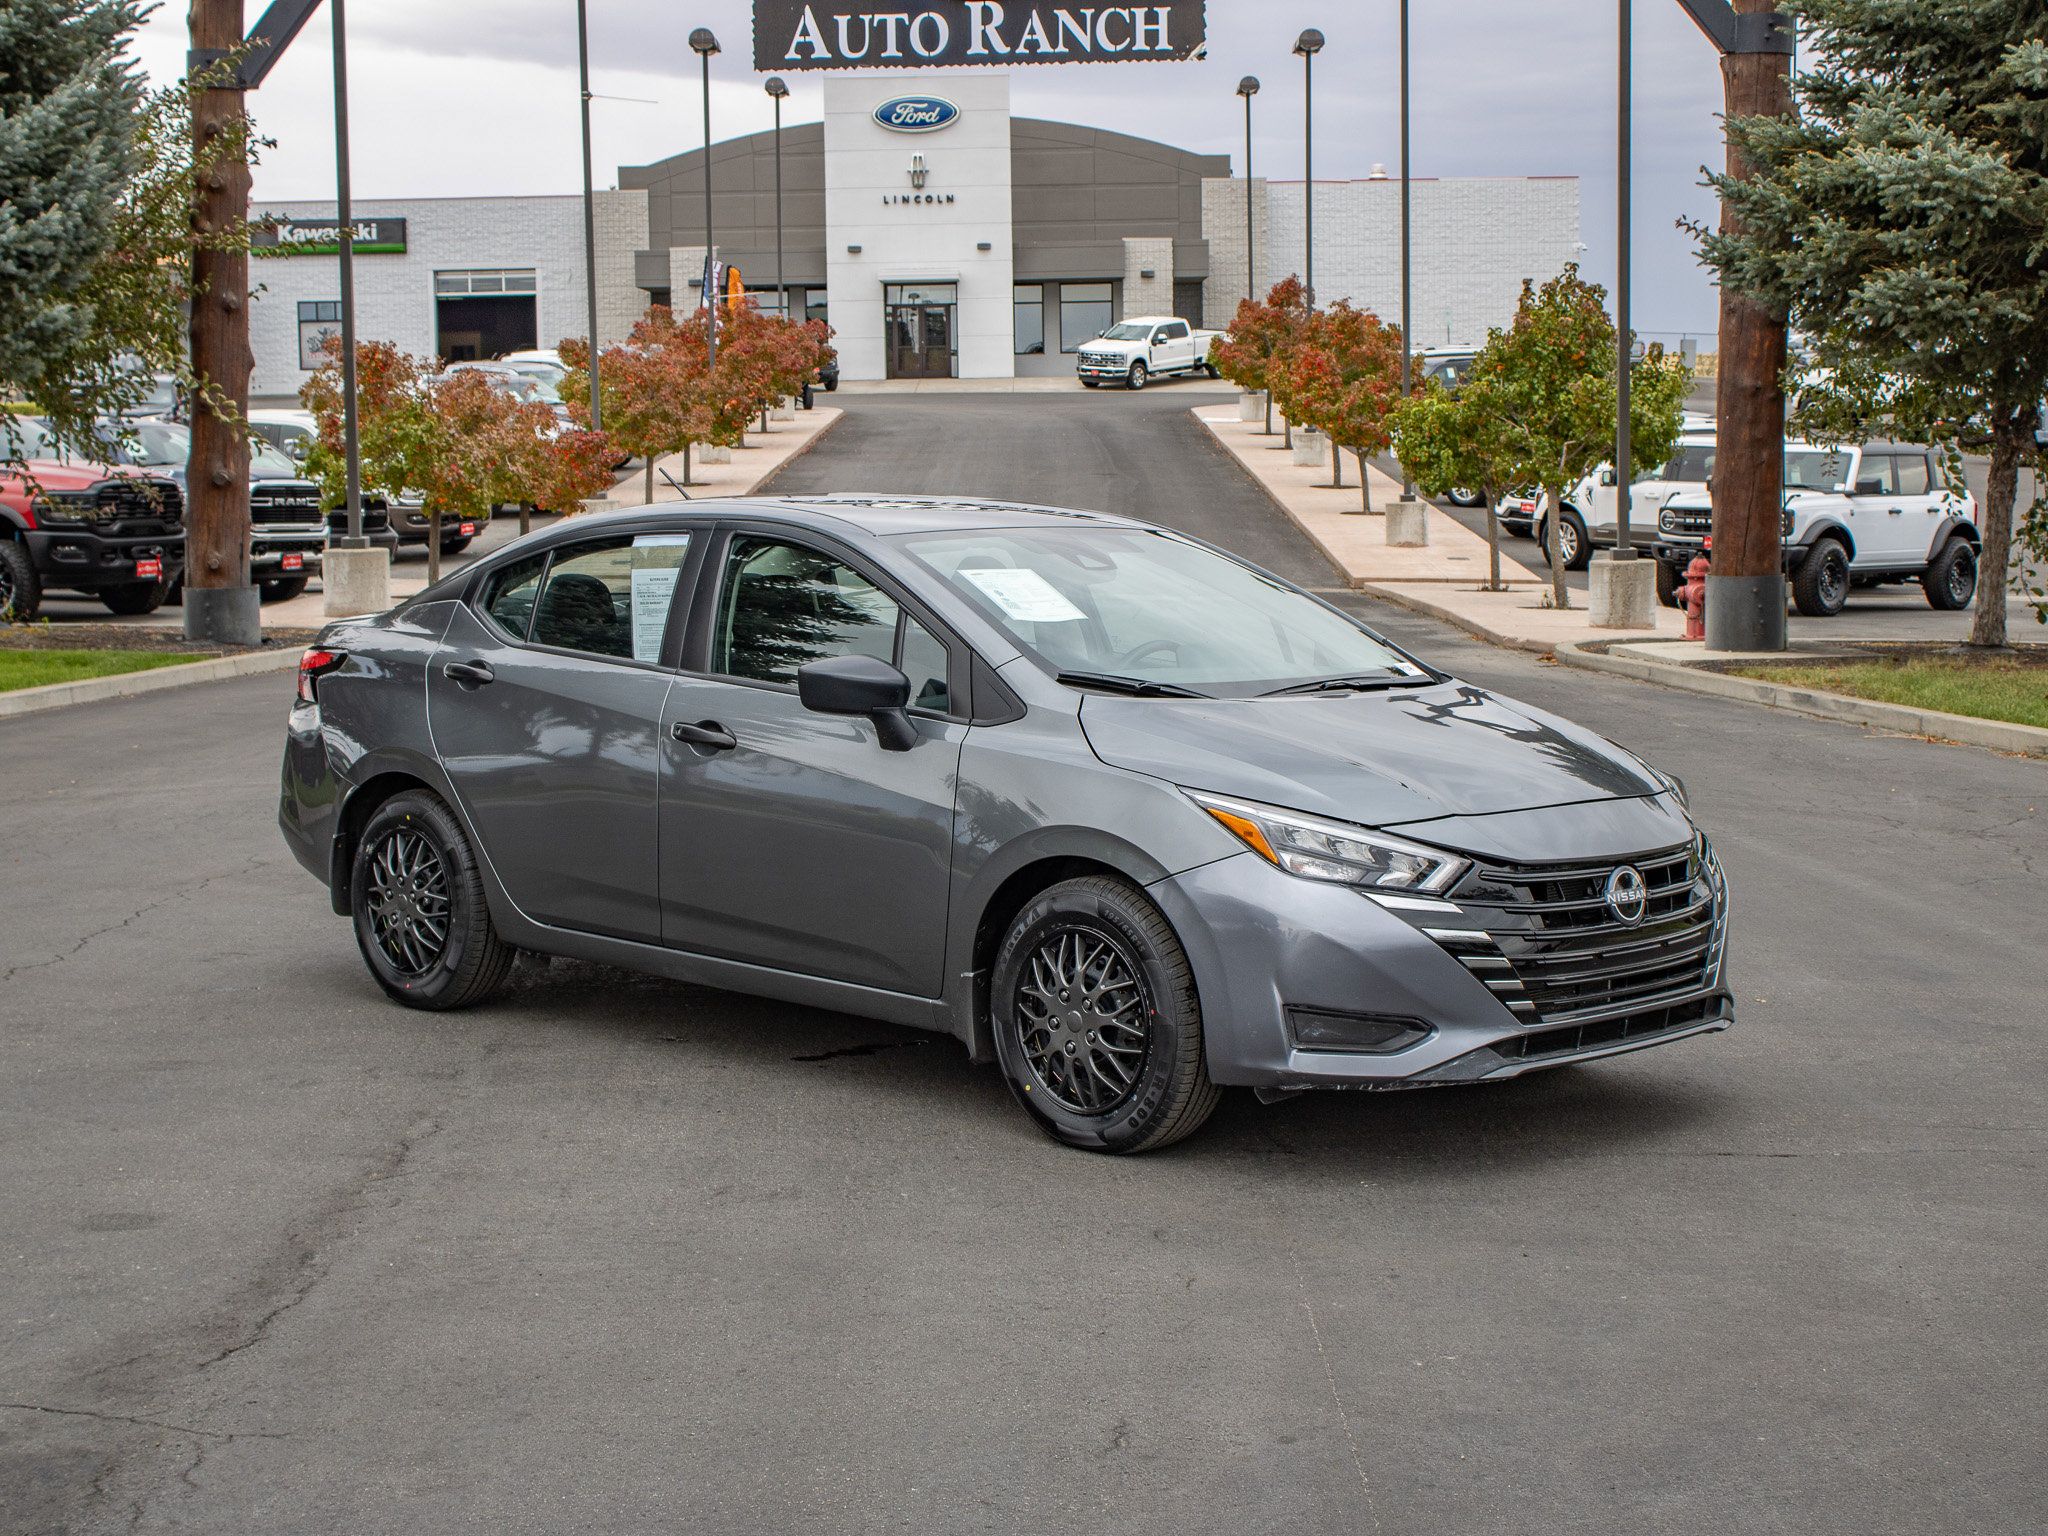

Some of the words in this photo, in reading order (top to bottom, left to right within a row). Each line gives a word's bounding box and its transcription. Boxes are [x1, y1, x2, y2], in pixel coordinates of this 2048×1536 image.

[784, 4, 950, 59] AUTO
[964, 0, 1174, 55] RANCH
[891, 102, 941, 124] Ford
[883, 194, 954, 205] LINCOLN
[277, 222, 378, 242] Kawaki
[274, 497, 306, 506] RAM
[1607, 889, 1646, 903] NISSAN
